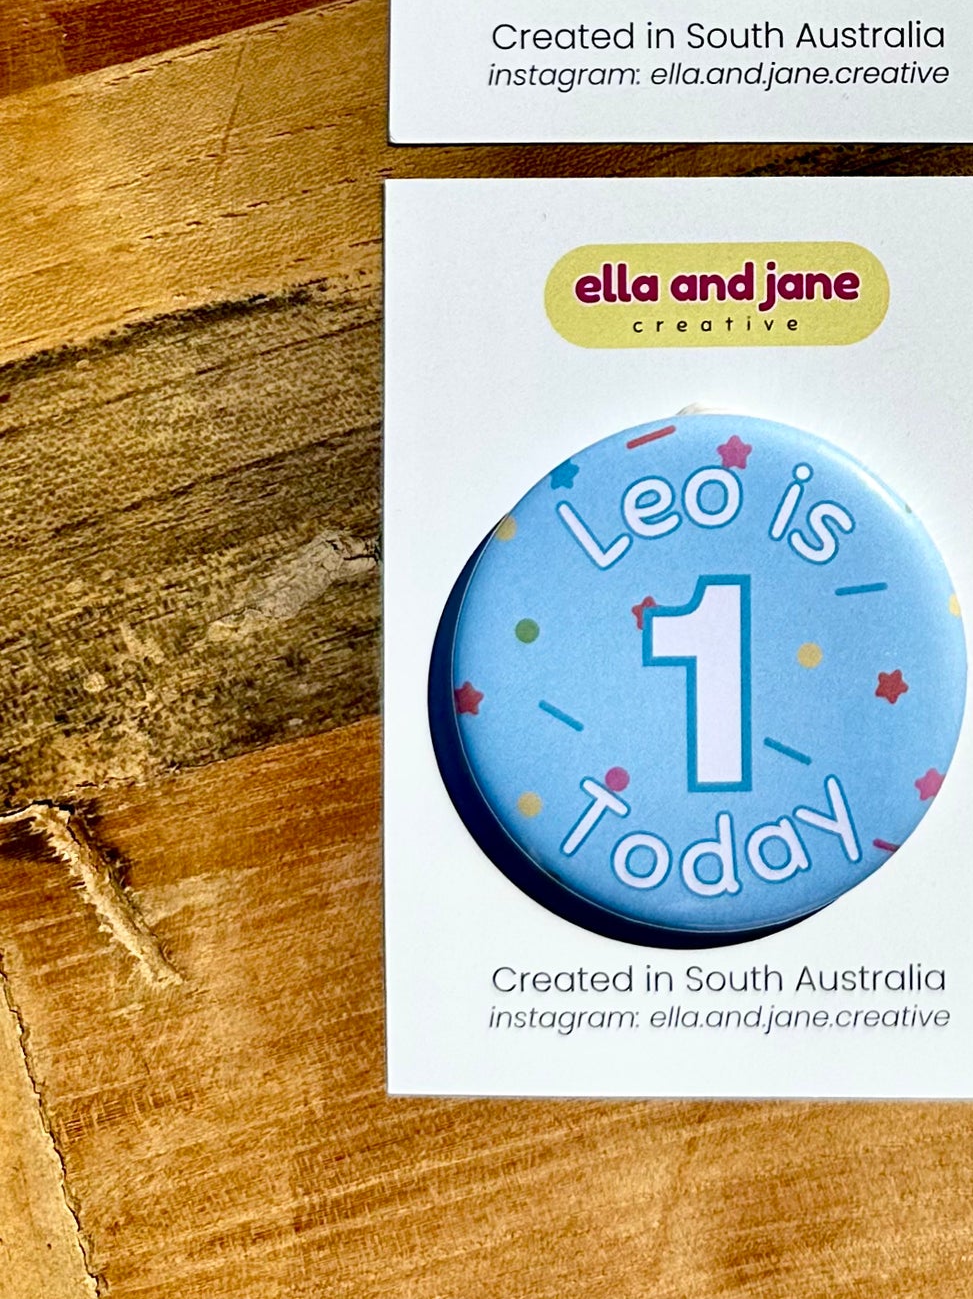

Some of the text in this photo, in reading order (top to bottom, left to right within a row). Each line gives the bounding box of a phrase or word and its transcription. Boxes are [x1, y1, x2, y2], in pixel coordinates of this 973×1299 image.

[492, 20, 944, 50] Created in South Australia
[488, 62, 950, 93] instagram: ella.and.jane.creative
[574, 261, 860, 312] ella and jane
[632, 316, 799, 334] creative
[556, 461, 856, 571] Leo is
[642, 574, 752, 792] 1
[560, 774, 861, 898] Today
[492, 963, 946, 994] Created in South Australia
[488, 1005, 950, 1036] instagram: ella.and.jane.creative
